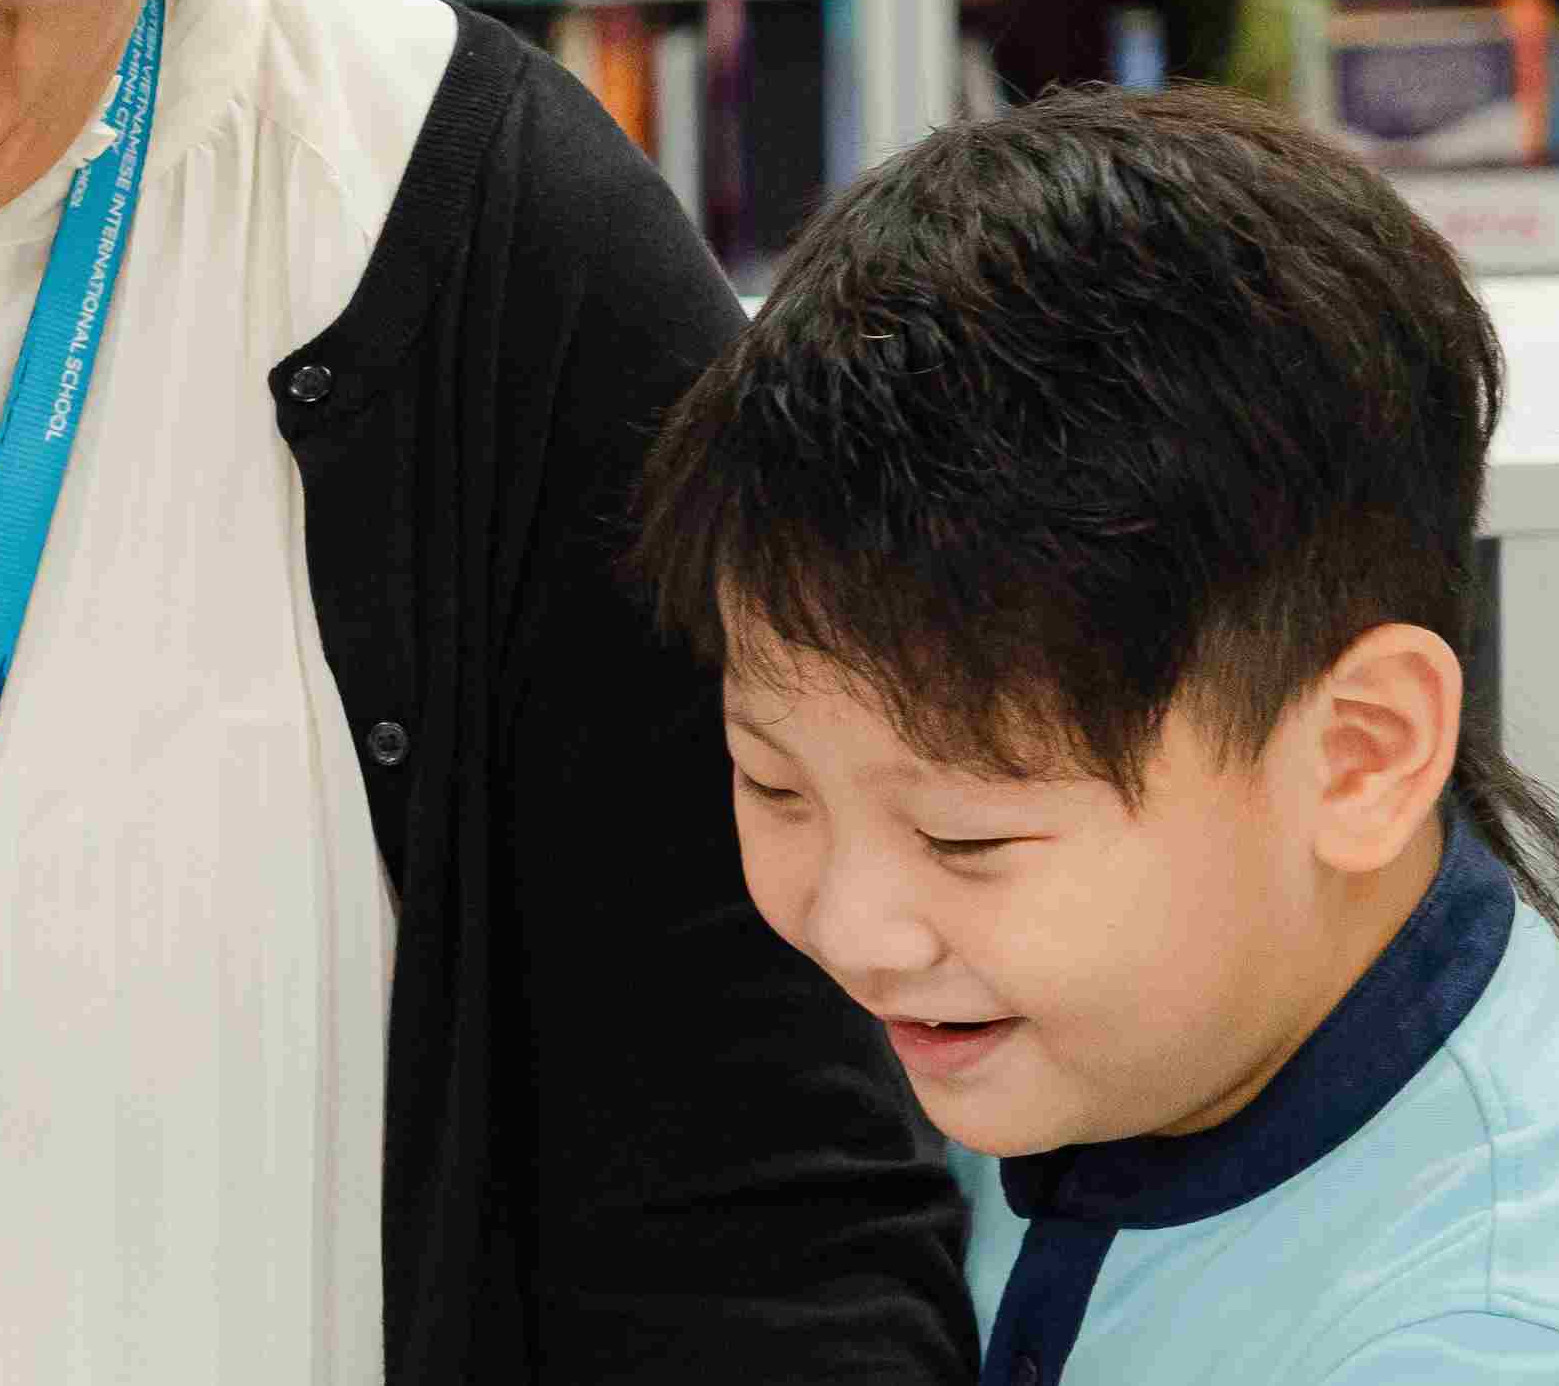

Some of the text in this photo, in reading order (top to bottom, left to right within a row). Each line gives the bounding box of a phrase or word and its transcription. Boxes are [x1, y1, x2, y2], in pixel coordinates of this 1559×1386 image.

[116, 64, 153, 190] VIETNAMESE
[69, 192, 127, 354] INTERNATIONAL
[44, 356, 83, 442] SCHOOL
